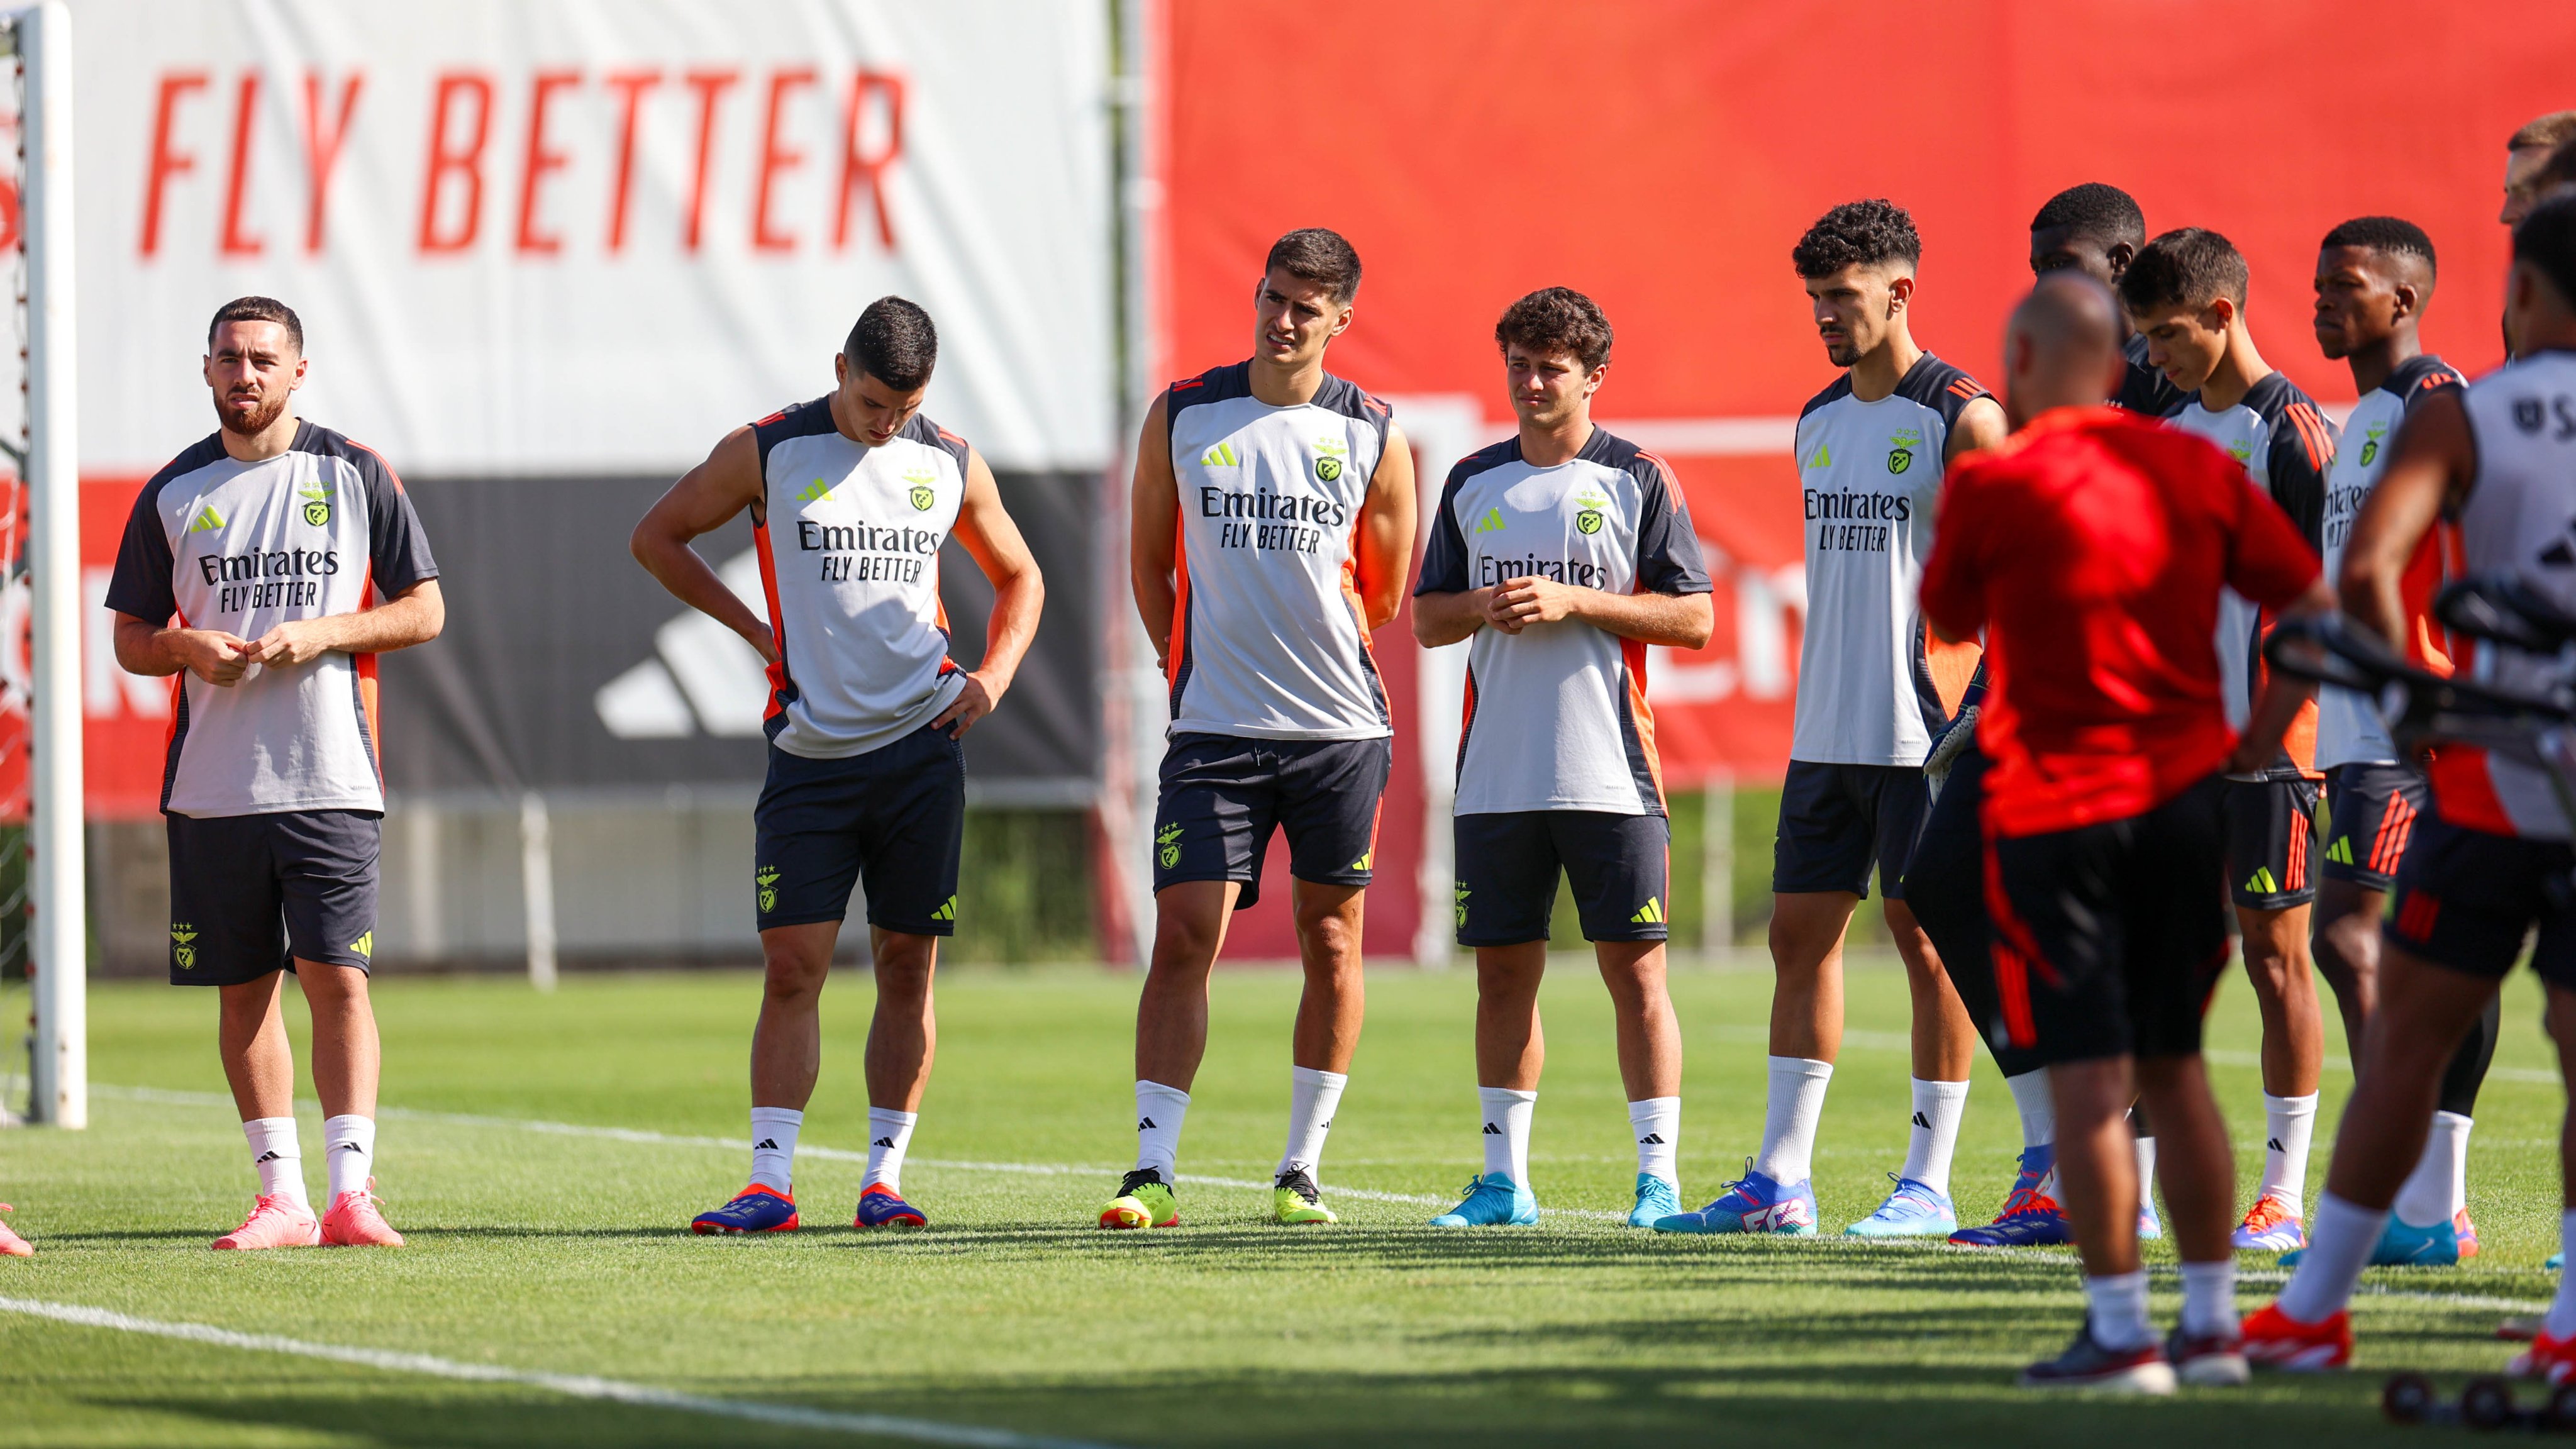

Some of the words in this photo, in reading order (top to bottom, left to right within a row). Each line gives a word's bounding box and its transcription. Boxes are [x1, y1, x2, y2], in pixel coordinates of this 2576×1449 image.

[136, 69, 366, 257] FLY
[418, 68, 911, 256] BETTER
[1200, 486, 1345, 527] Emirates
[1804, 486, 1910, 521] Emirates
[796, 519, 940, 556] Emirates
[1221, 523, 1252, 548] FLY
[1257, 525, 1321, 553] BETTER
[1819, 525, 1836, 550] LY
[1838, 525, 1887, 552] BETTER
[198, 546, 339, 586] Emirates
[821, 556, 853, 581] FLY
[858, 556, 922, 584] BETTER
[1480, 552, 1607, 591] Emirates
[221, 586, 250, 613] FLY
[252, 581, 317, 609] BETTER
